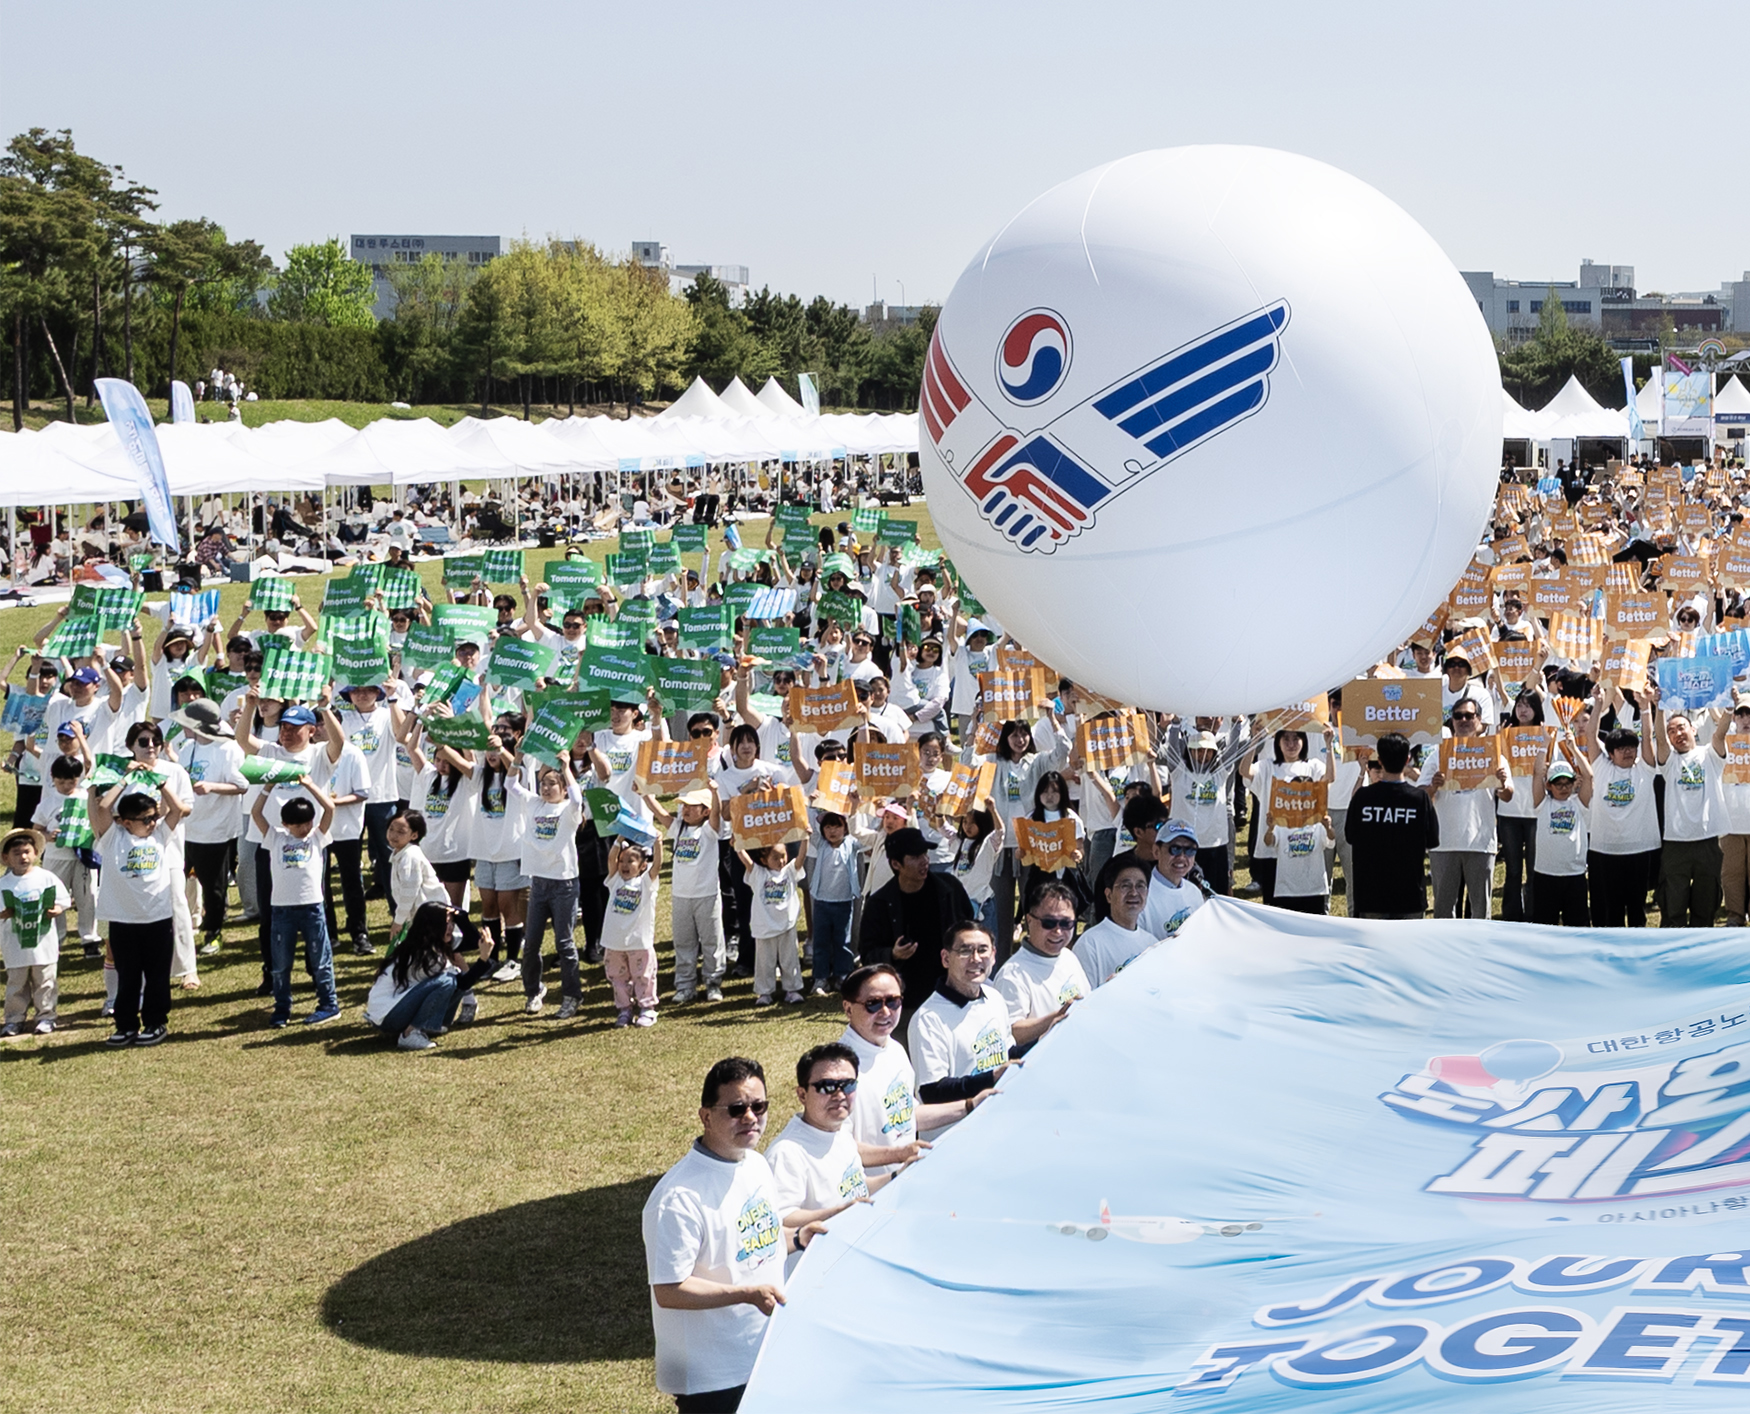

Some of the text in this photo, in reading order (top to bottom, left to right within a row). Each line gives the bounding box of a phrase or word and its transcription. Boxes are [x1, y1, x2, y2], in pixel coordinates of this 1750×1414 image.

[1554, 523, 1575, 531] Better
[1686, 518, 1707, 526] Better
[673, 535, 702, 543] Tomorrow
[786, 534, 816, 542] Tomorrow
[882, 528, 912, 537] Tomorrow
[1500, 543, 1523, 555] Better
[551, 574, 595, 584] Tomorrow
[1497, 572, 1525, 581] Better
[1669, 568, 1701, 578] Better
[1456, 594, 1488, 605] Better
[1535, 593, 1570, 604] Better
[438, 617, 488, 627] Tomorrow
[1617, 610, 1658, 623] Better
[683, 622, 729, 633] Tomorrow
[593, 636, 639, 647] Tomorrow
[1556, 630, 1594, 645] Better
[408, 639, 452, 653] Tomorrow
[751, 644, 792, 654] Tomorrow
[336, 654, 384, 668] Tomorrow
[494, 654, 539, 672] Tomorrow
[1500, 656, 1533, 667] Better
[1605, 657, 1643, 674] Better
[267, 667, 325, 683] Tomorrow
[588, 665, 645, 685] Tomorrow
[659, 677, 712, 692] Tomorrow
[983, 688, 1031, 703] Better
[574, 708, 601, 719] rrow
[801, 702, 849, 717] Better
[1365, 705, 1419, 721] Better
[1087, 736, 1134, 752] Better
[1512, 745, 1539, 758] Bett
[651, 760, 698, 775] Better
[1449, 755, 1491, 770] Better
[862, 763, 906, 777] Better
[743, 808, 793, 828] Better
[1362, 806, 1417, 824] STAFF
